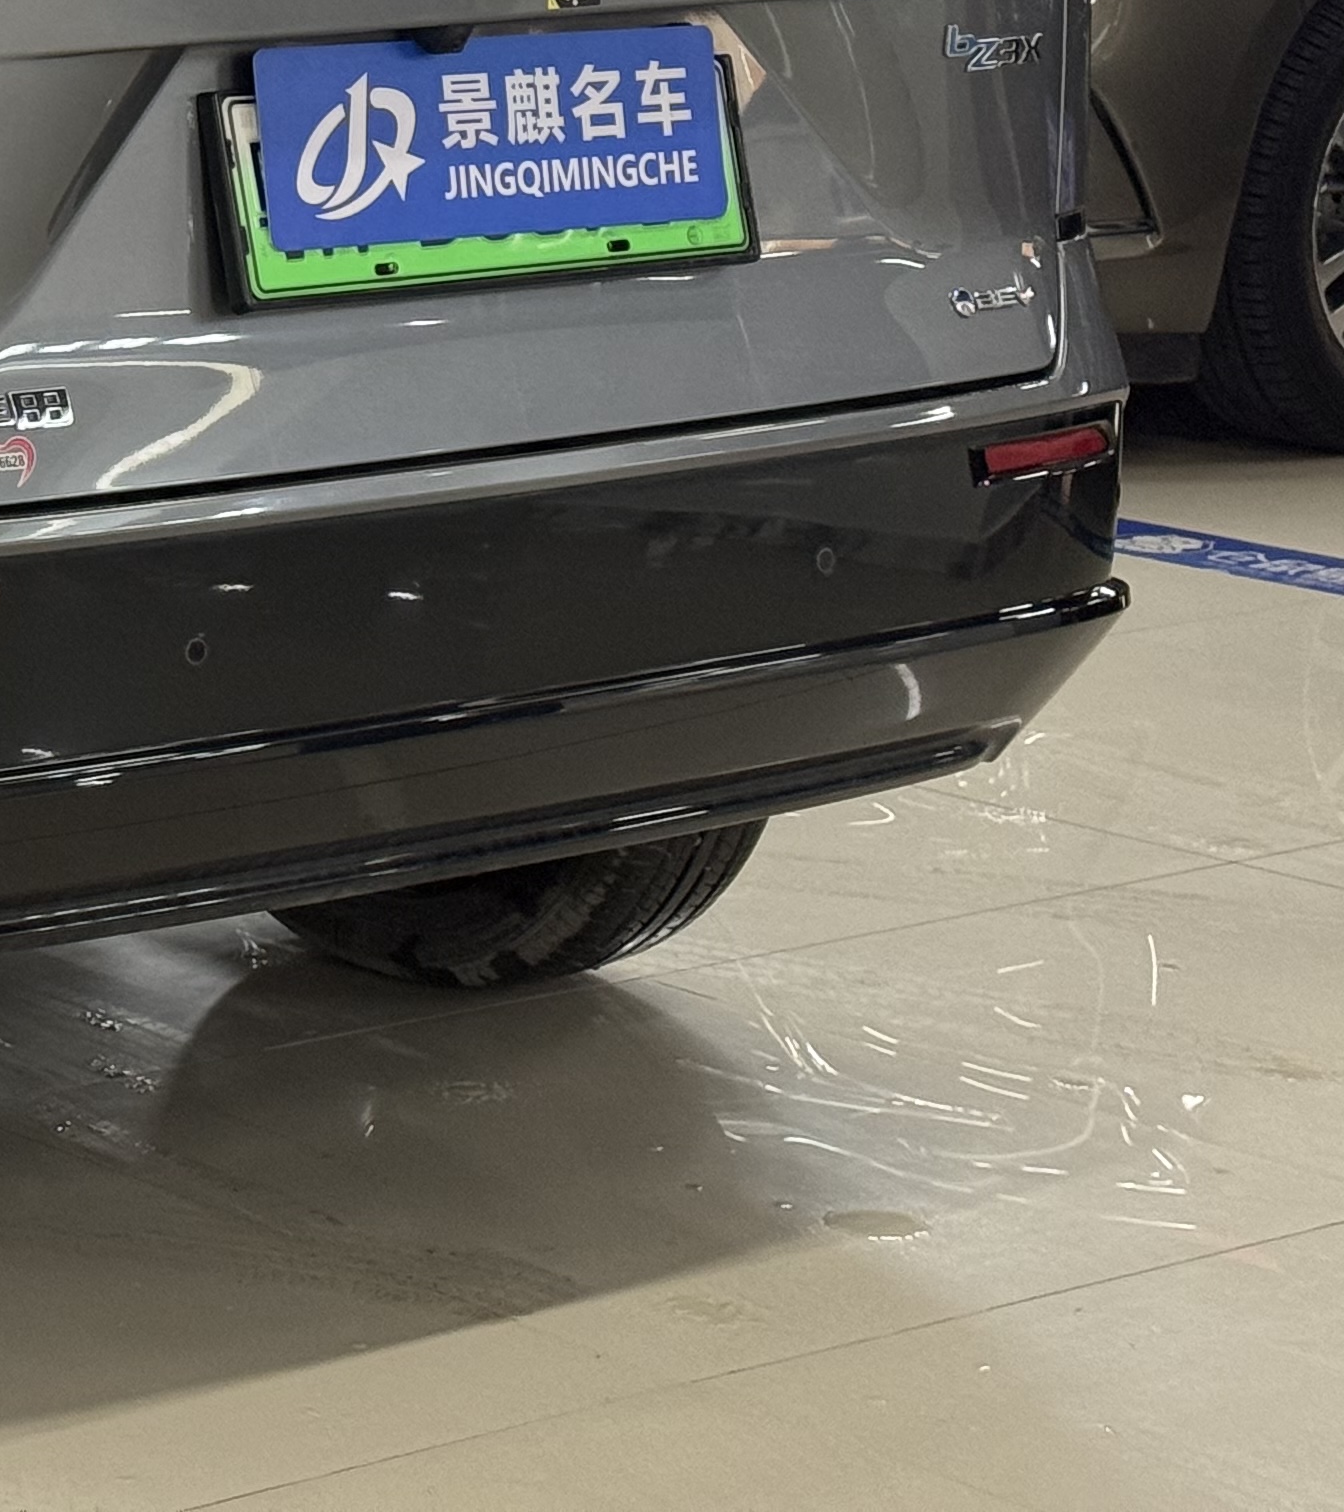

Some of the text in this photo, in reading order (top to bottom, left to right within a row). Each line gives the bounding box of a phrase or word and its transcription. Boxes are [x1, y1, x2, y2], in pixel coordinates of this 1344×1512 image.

[438, 59, 693, 151] 景麒名车
[444, 149, 700, 201] JINGQIMINGCHE
